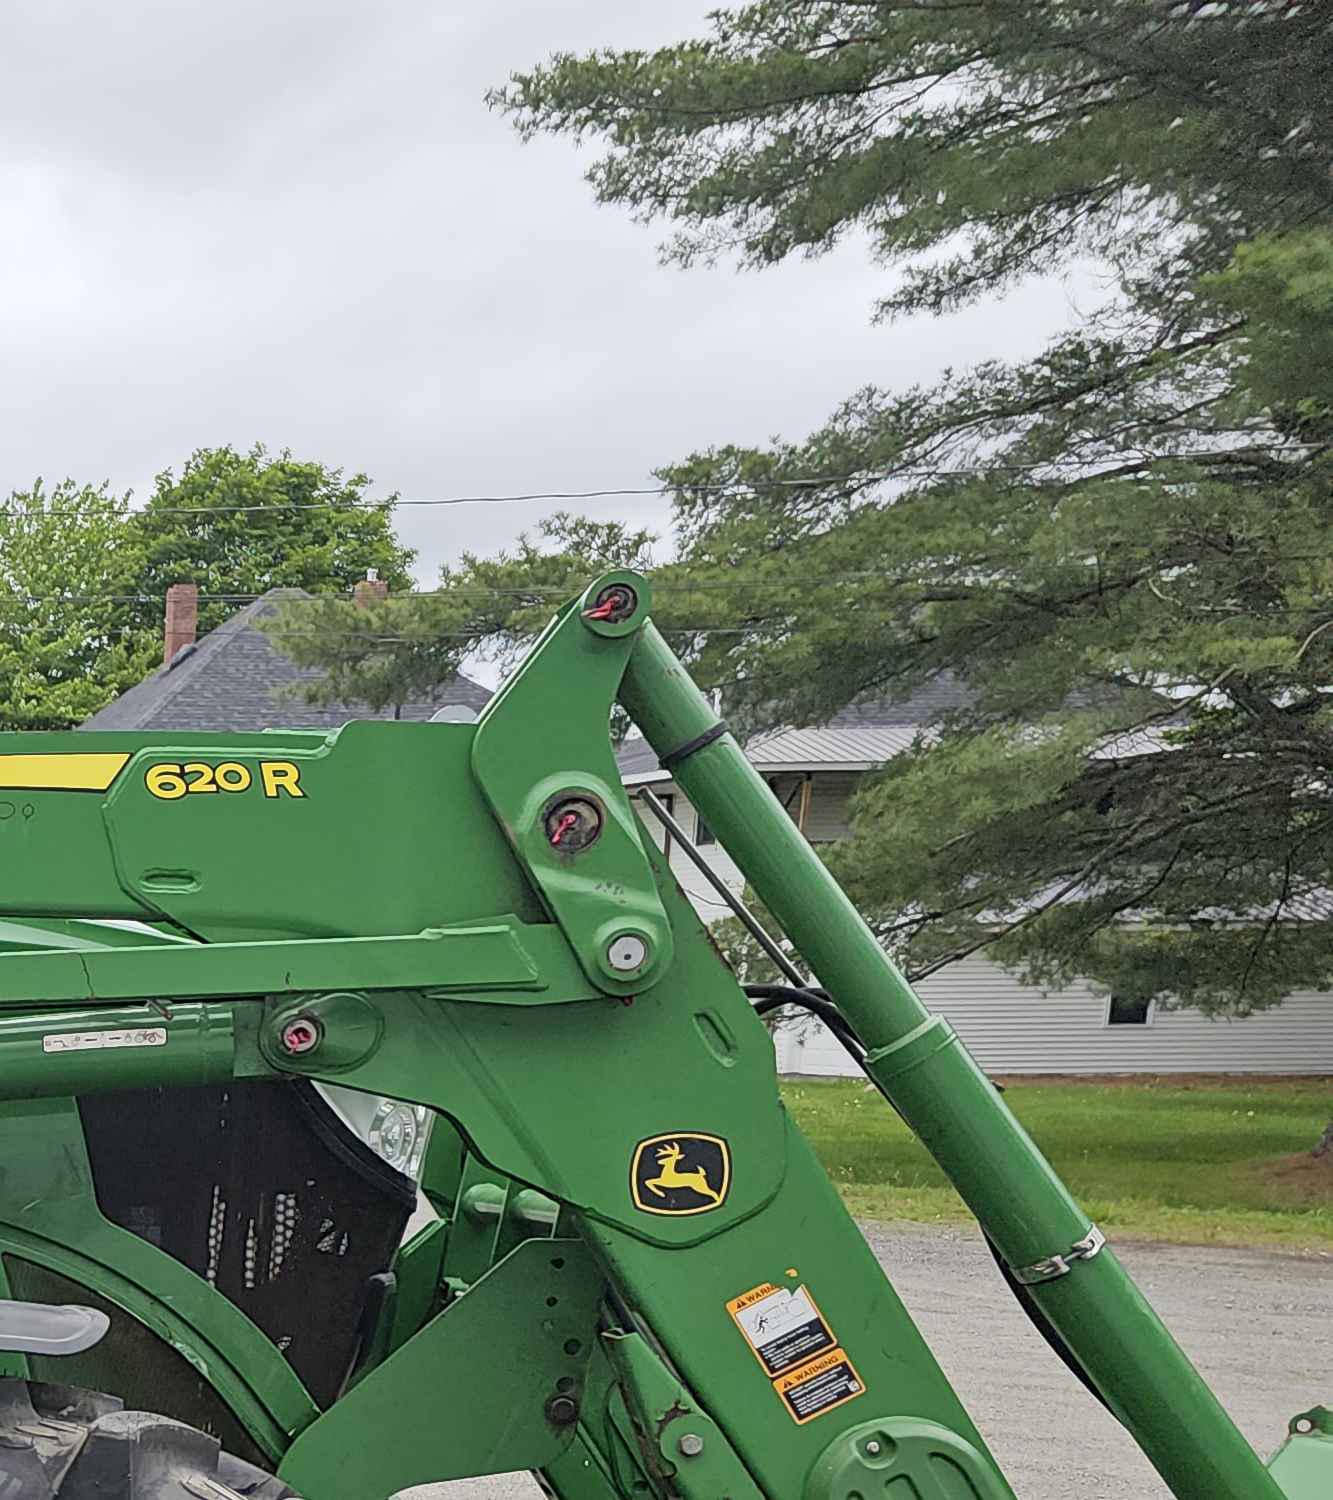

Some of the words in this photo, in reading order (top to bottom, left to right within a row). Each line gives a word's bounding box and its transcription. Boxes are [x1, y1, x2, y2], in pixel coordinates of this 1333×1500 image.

[144, 761, 253, 800] 620
[259, 761, 309, 799] R
[794, 1355, 839, 1382] WARNING
